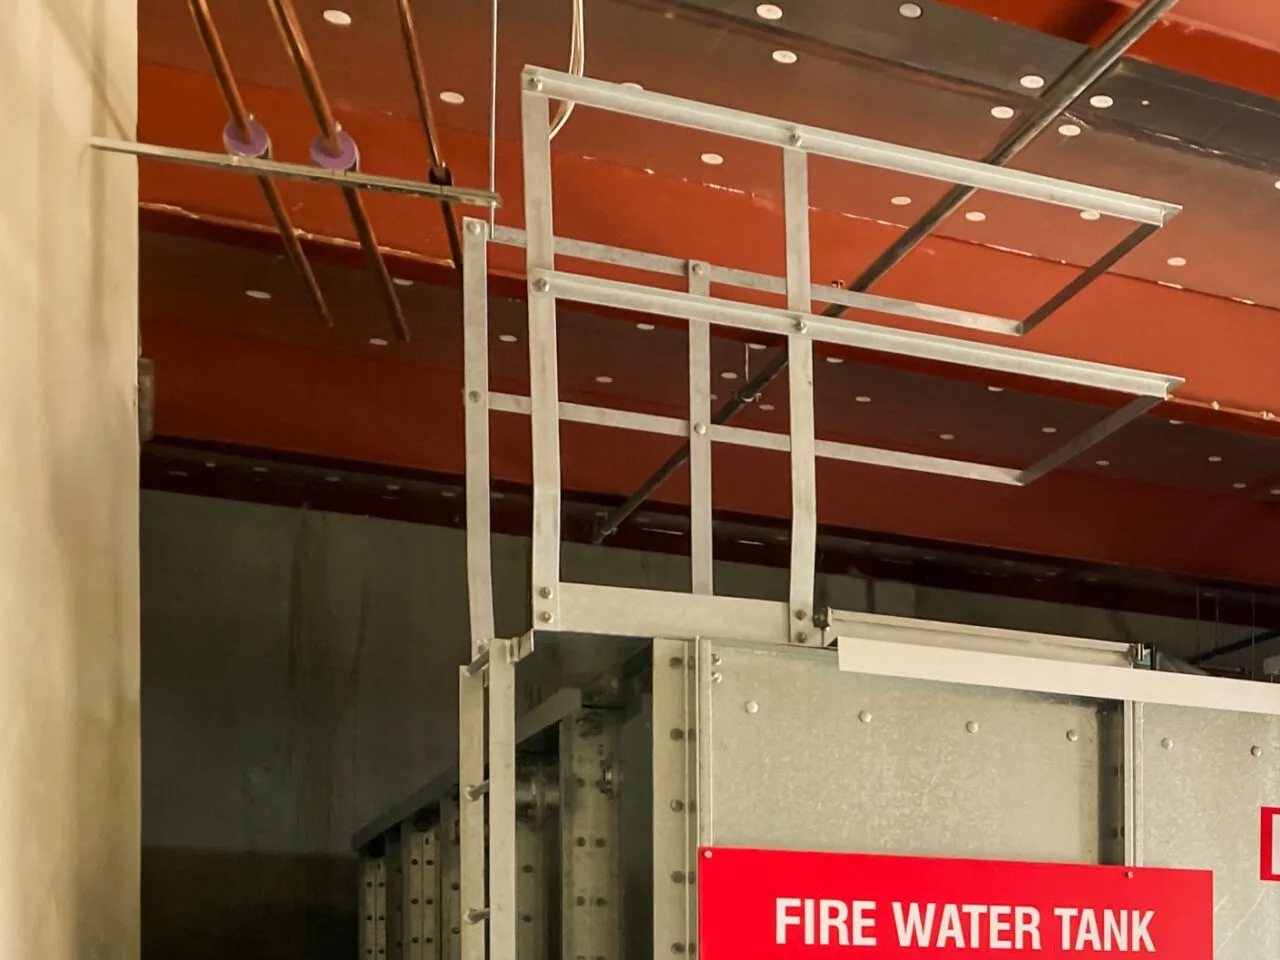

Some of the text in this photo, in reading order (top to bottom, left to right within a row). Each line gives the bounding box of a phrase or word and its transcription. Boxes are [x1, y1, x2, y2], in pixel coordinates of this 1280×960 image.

[775, 897, 1156, 953] FIRE WATER TANK
